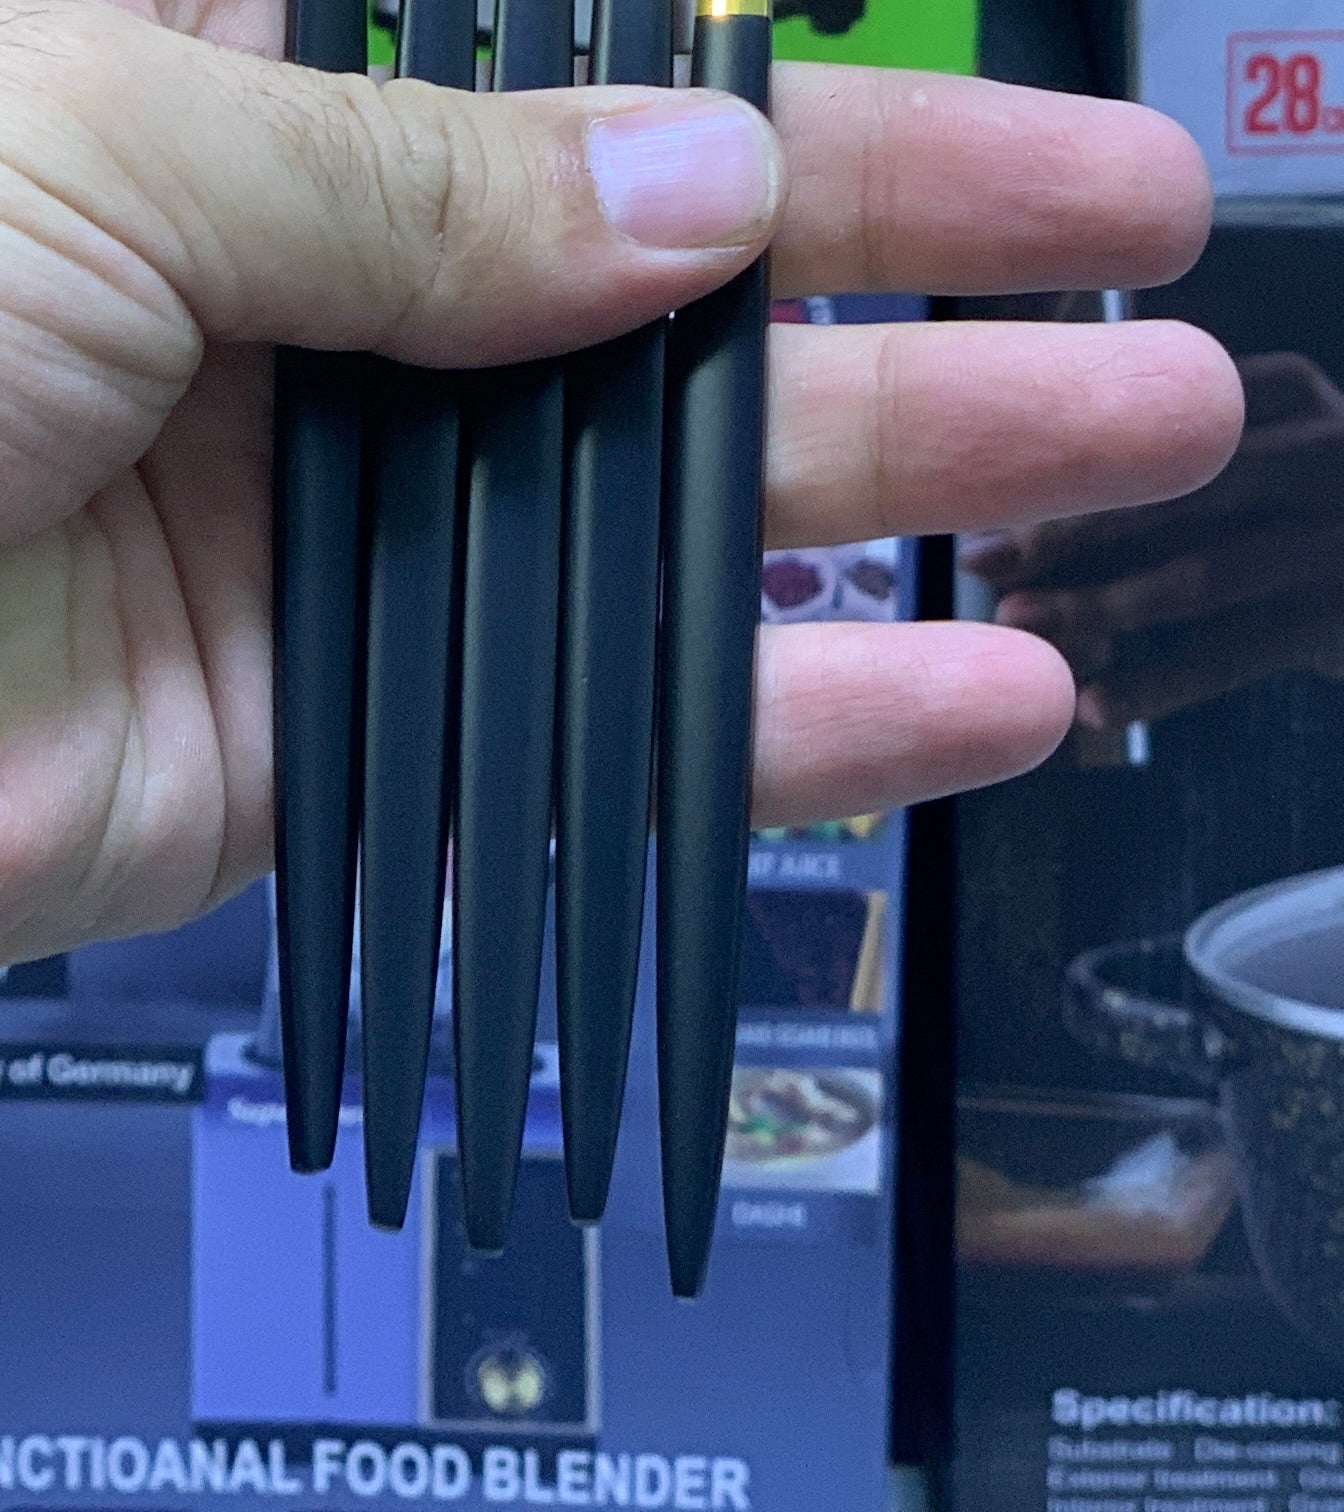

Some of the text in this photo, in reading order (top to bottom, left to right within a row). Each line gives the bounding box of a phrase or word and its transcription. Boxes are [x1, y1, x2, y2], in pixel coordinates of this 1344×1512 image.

[9, 1053, 46, 1085] of
[48, 1052, 193, 1095] Germany
[312, 1438, 469, 1496] FOOD
[482, 1445, 751, 1510] BLENDER
